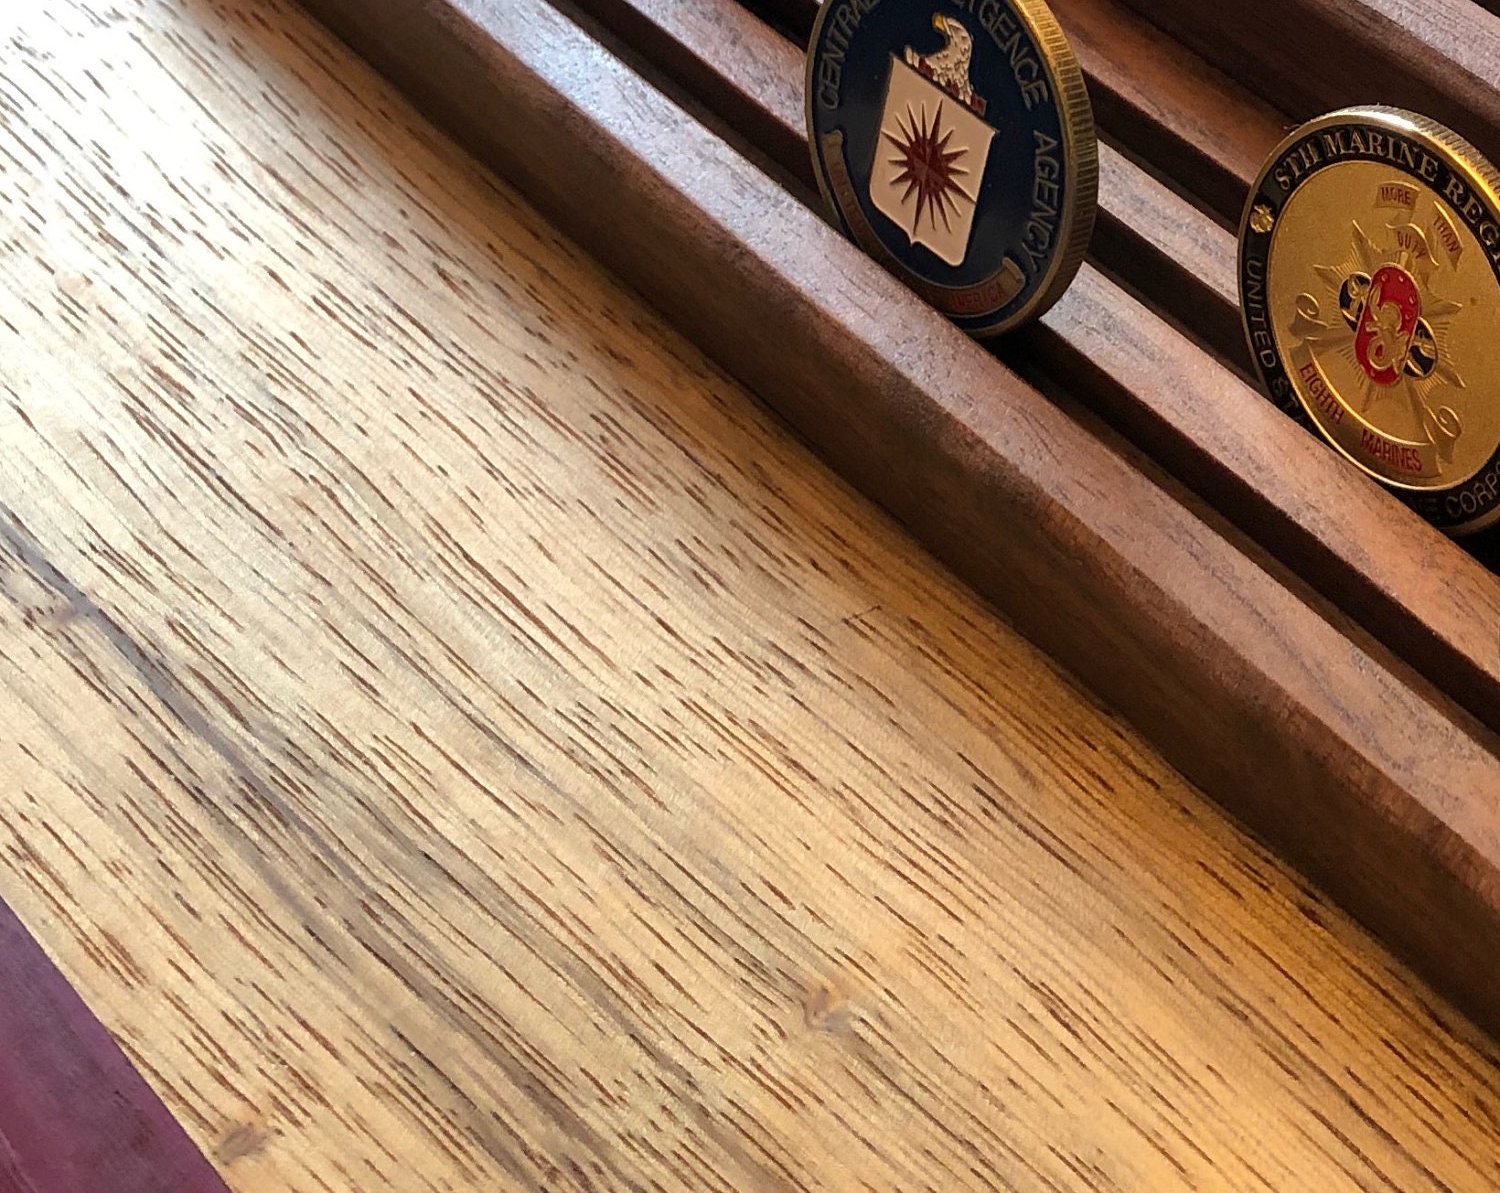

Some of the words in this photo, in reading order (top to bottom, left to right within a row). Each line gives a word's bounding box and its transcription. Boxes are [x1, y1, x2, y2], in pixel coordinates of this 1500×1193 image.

[1323, 129, 1438, 182] MARINE
[1022, 129, 1060, 274] AGENCY
[1381, 186, 1412, 206] MORE
[1397, 230, 1427, 260] DUTY
[1247, 261, 1278, 369] UNITED
[1299, 361, 1345, 426] EIGHTH
[1359, 428, 1423, 473] MARINES
